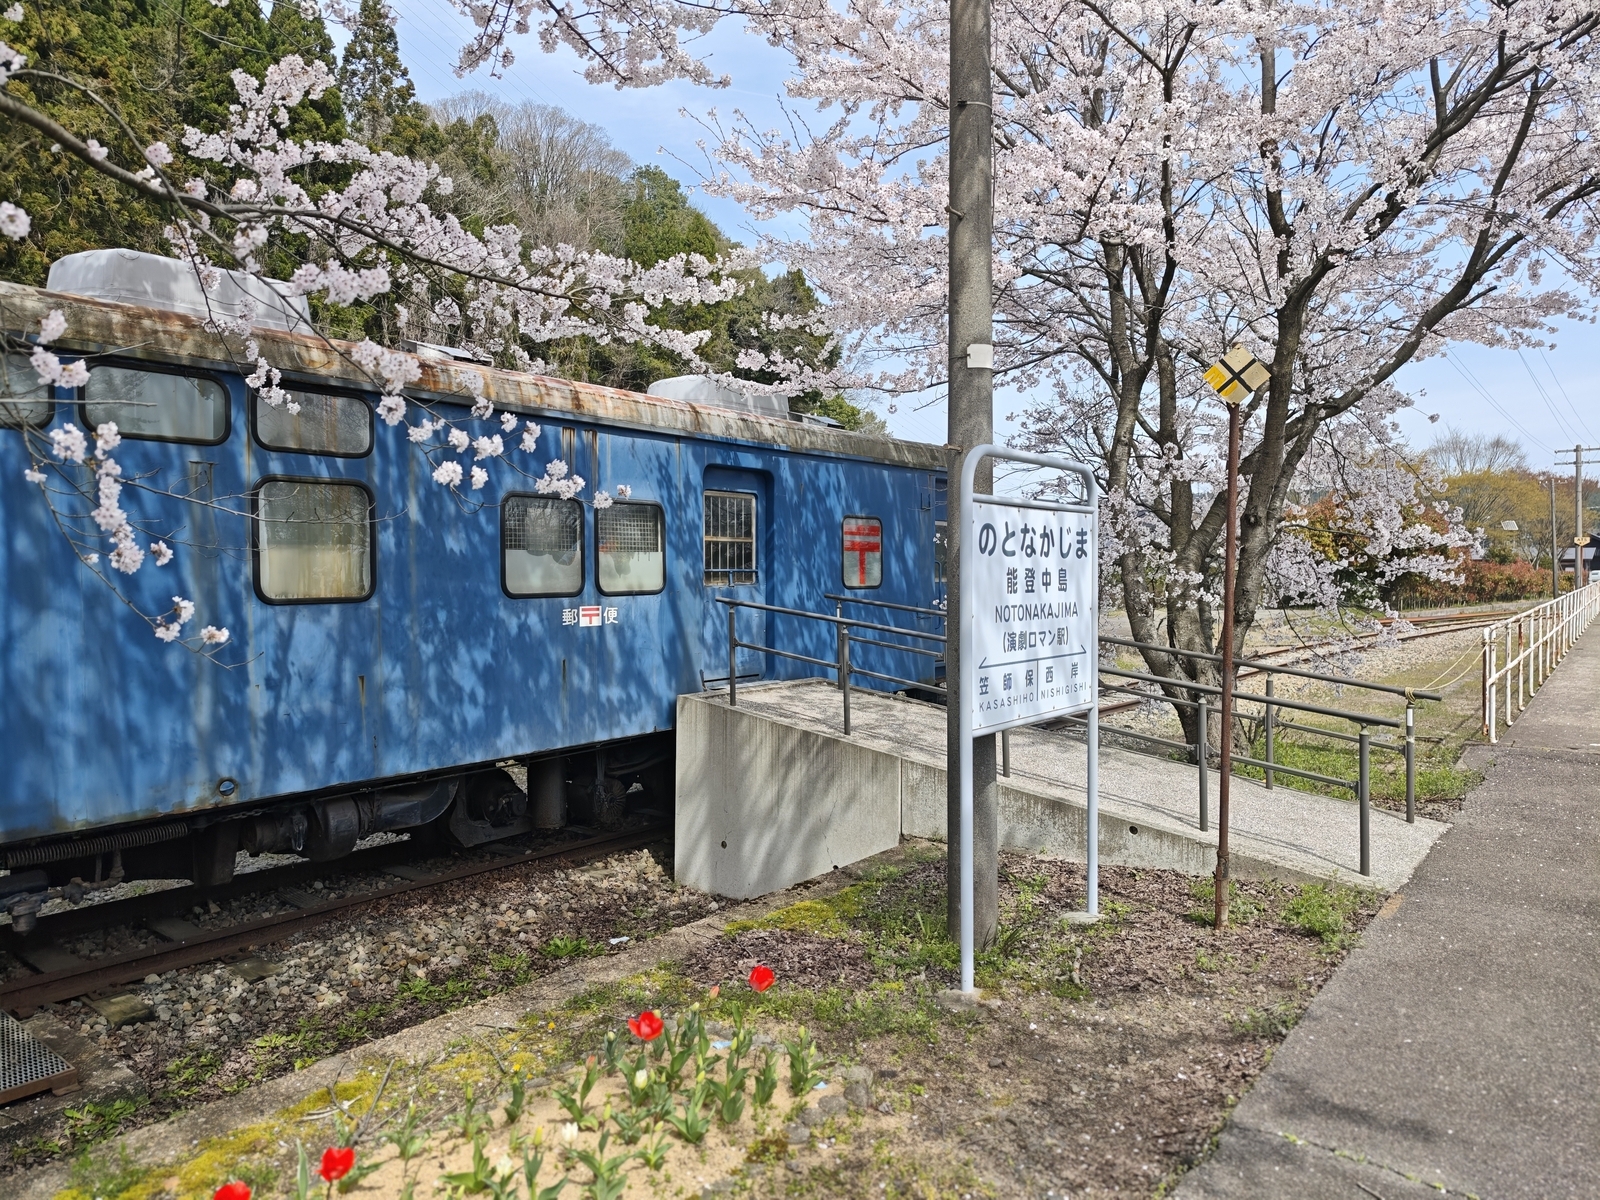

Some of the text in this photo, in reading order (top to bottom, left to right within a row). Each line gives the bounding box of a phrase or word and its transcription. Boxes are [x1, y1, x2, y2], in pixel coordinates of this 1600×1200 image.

[979, 521, 1087, 559] のとなかじま
[1006, 567, 1068, 594] 能登中島
[995, 602, 1078, 623] NOTONAKAJIMA
[1040, 682, 1087, 700] NISHIGISHI
[979, 692, 1034, 713] KASASHIHO
